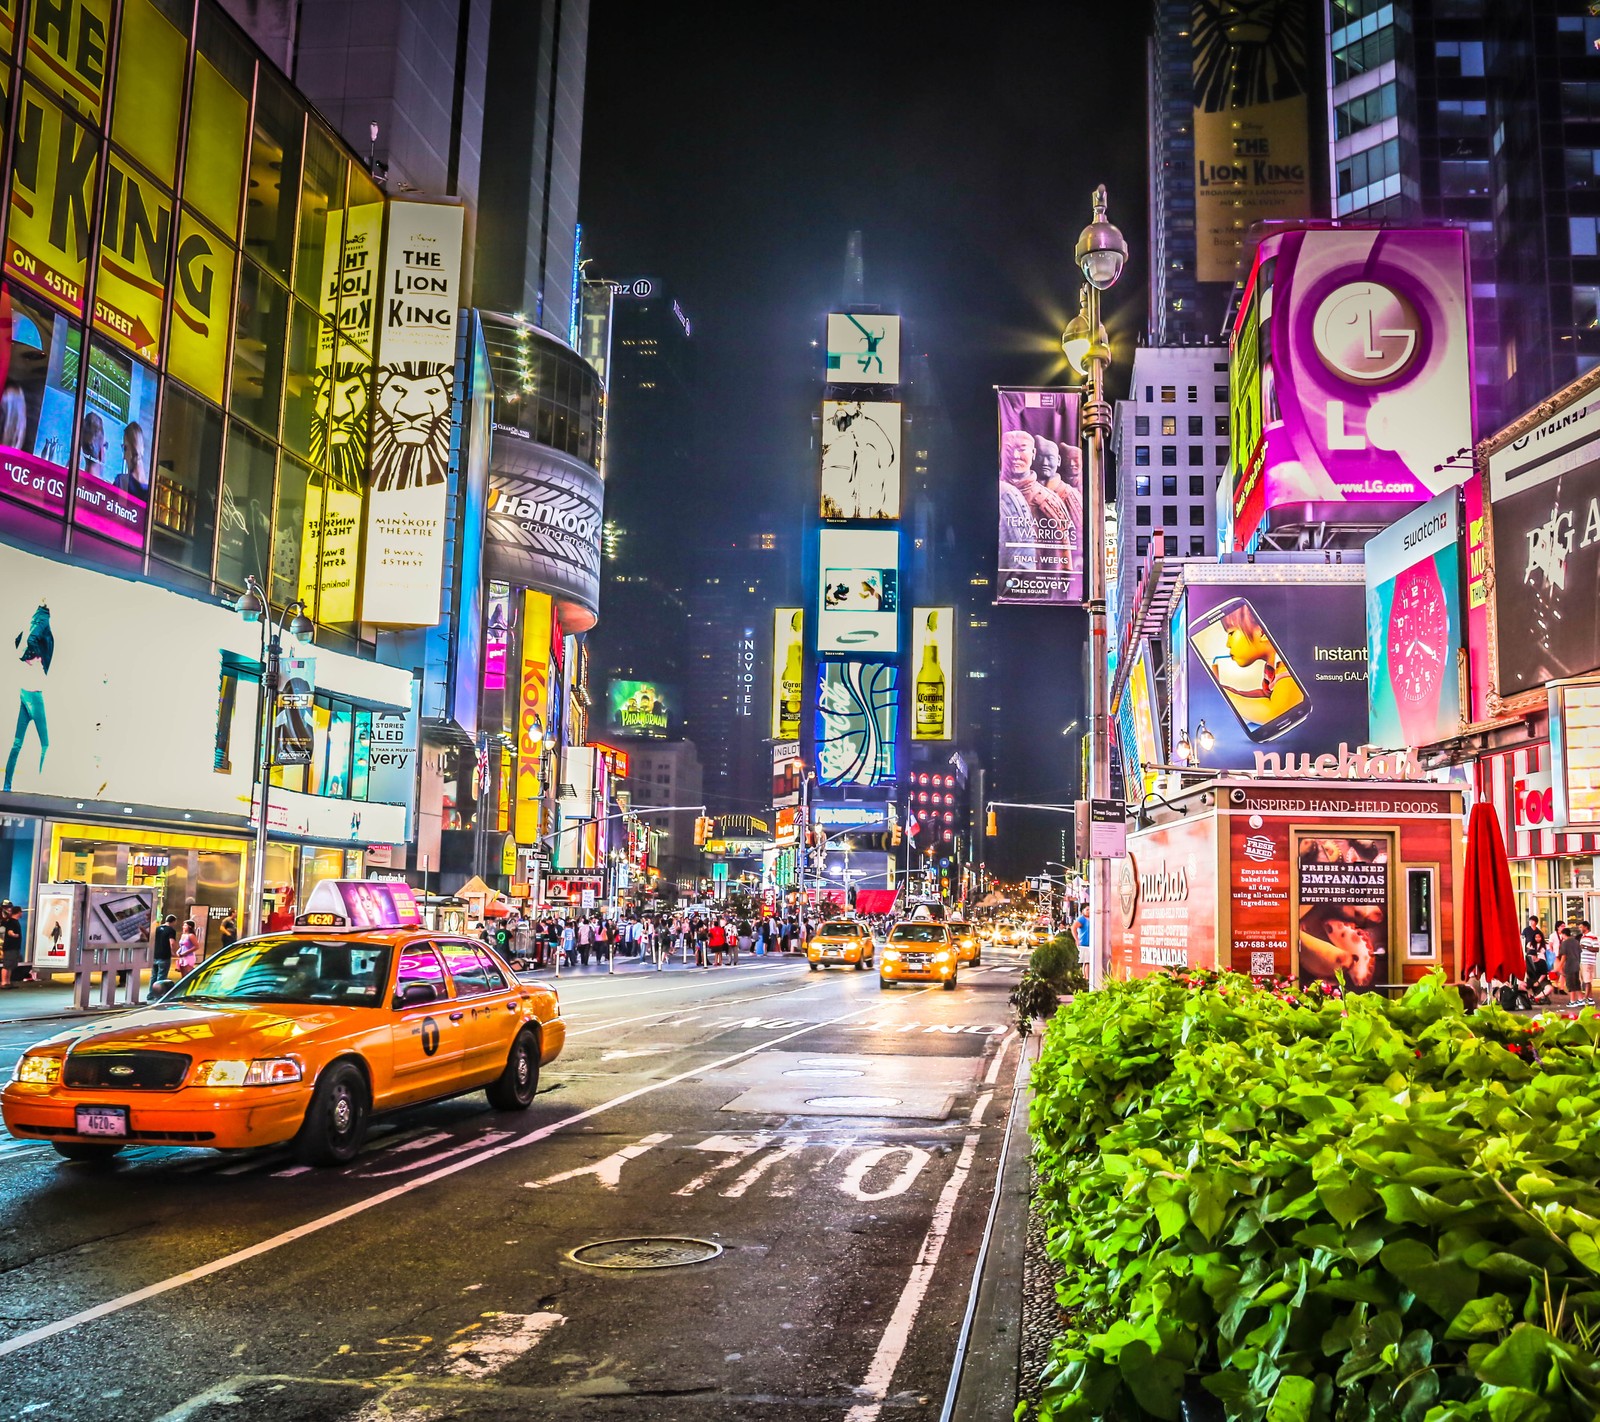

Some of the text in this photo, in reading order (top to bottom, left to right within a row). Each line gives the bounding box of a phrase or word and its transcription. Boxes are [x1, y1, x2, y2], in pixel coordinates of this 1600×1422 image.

[1233, 138, 1269, 154] THE
[48, 88, 214, 319] KING
[402, 250, 441, 267] THE
[12, 249, 79, 302] ON 45TH
[95, 302, 134, 337] STREET
[388, 298, 451, 328] KING
[375, 518, 438, 529] MINSKOFF
[1005, 516, 1077, 531] TERRACOTTA
[379, 526, 433, 537] THEATRE
[520, 521, 563, 542] driving
[1017, 528, 1077, 541] WARRIORS
[1403, 514, 1440, 551] swatch
[1013, 555, 1069, 565] FINAL WEEKS
[1314, 646, 1368, 661] Instant
[743, 640, 754, 716] NOVOTEL
[1315, 673, 1344, 683] Samsung
[1245, 798, 1439, 814] INSPIRED HAND-HELD FOODS
[1246, 847, 1272, 858] BAKED
[1247, 840, 1273, 851] FRESH
[1241, 868, 1279, 876] Empanadas
[1301, 864, 1385, 873] FRESH BAKED
[1301, 873, 1385, 885] EMPANADAS
[1233, 891, 1252, 900] using
[307, 913, 334, 925] 4G20
